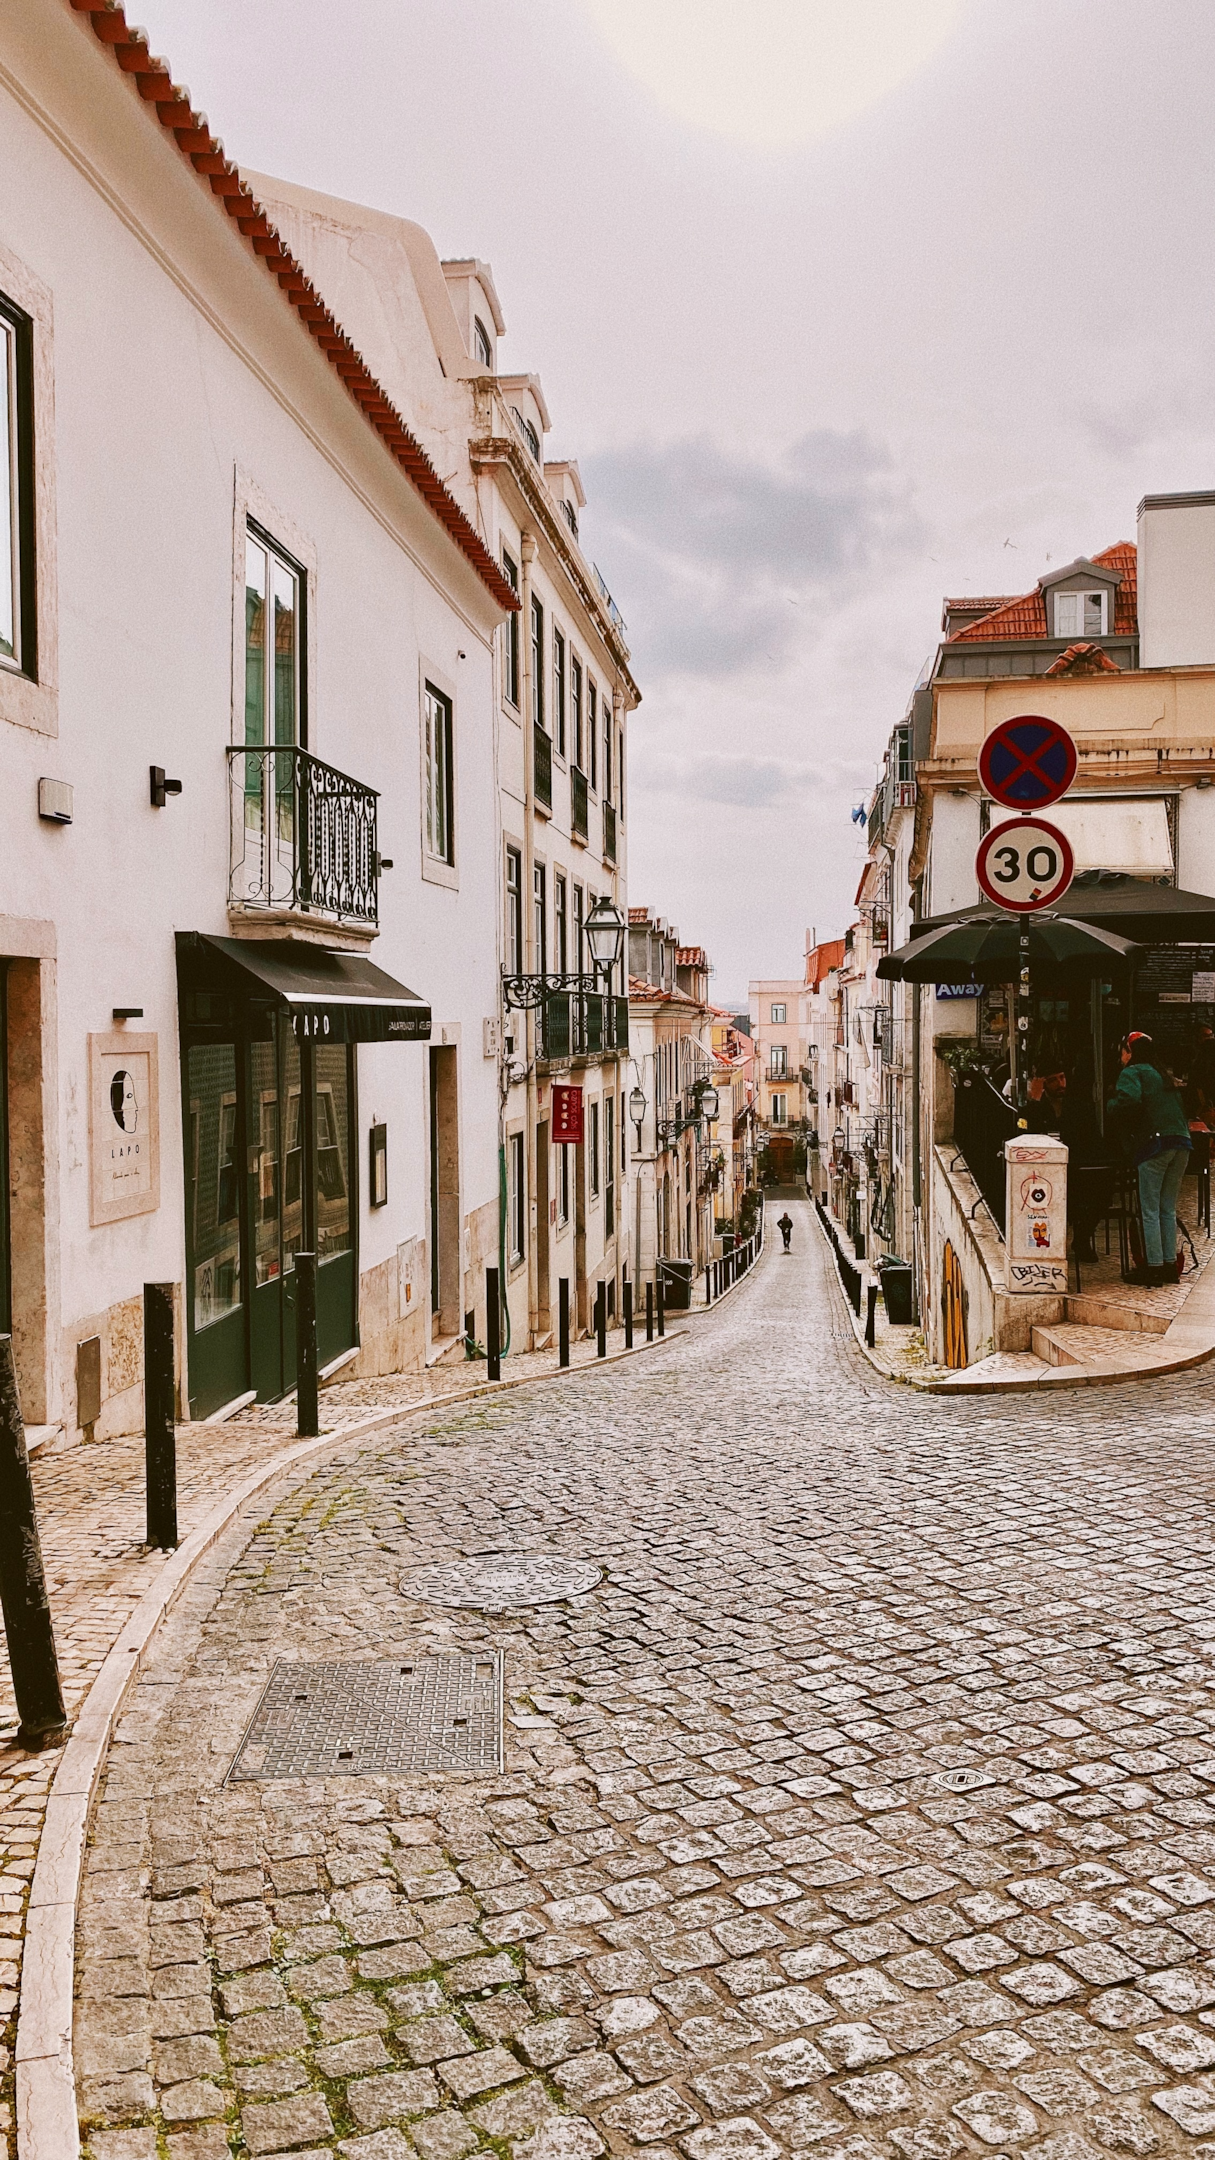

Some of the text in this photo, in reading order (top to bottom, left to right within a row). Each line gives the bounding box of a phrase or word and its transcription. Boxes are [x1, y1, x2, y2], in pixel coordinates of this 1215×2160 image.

[994, 846, 1057, 883] 30
[936, 983, 985, 997] Away
[111, 1144, 140, 1159] LAPO
